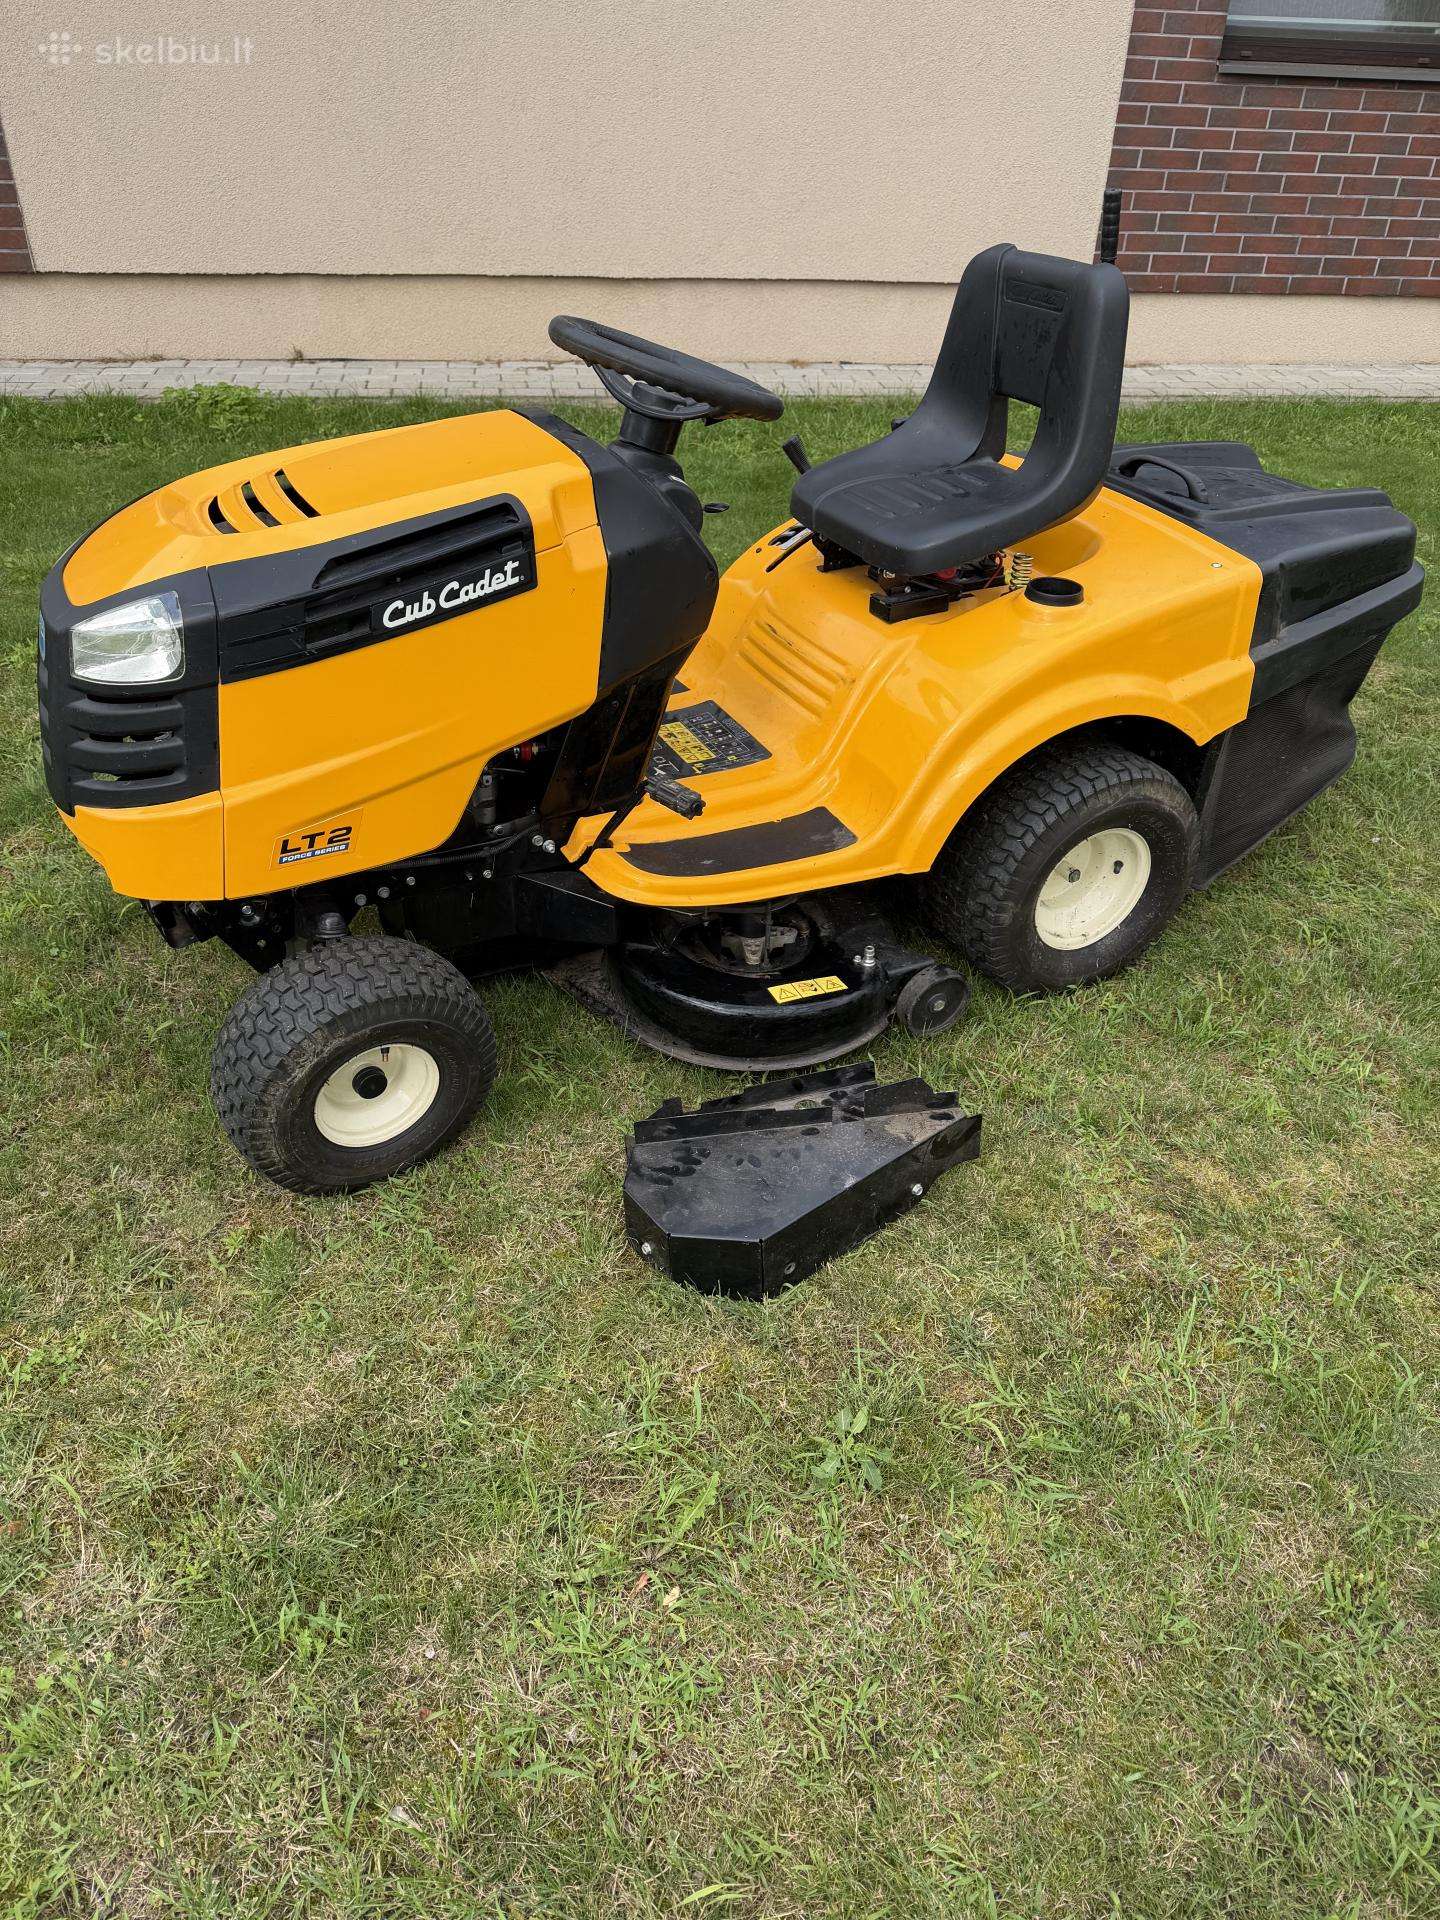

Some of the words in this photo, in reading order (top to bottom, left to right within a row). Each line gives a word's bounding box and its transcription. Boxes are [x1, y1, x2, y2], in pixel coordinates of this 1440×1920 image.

[383, 590, 436, 628] Cub
[439, 560, 520, 609] Cadet
[280, 826, 352, 854] LT2
[282, 852, 312, 862] FORCE
[314, 844, 346, 856] SERIES
